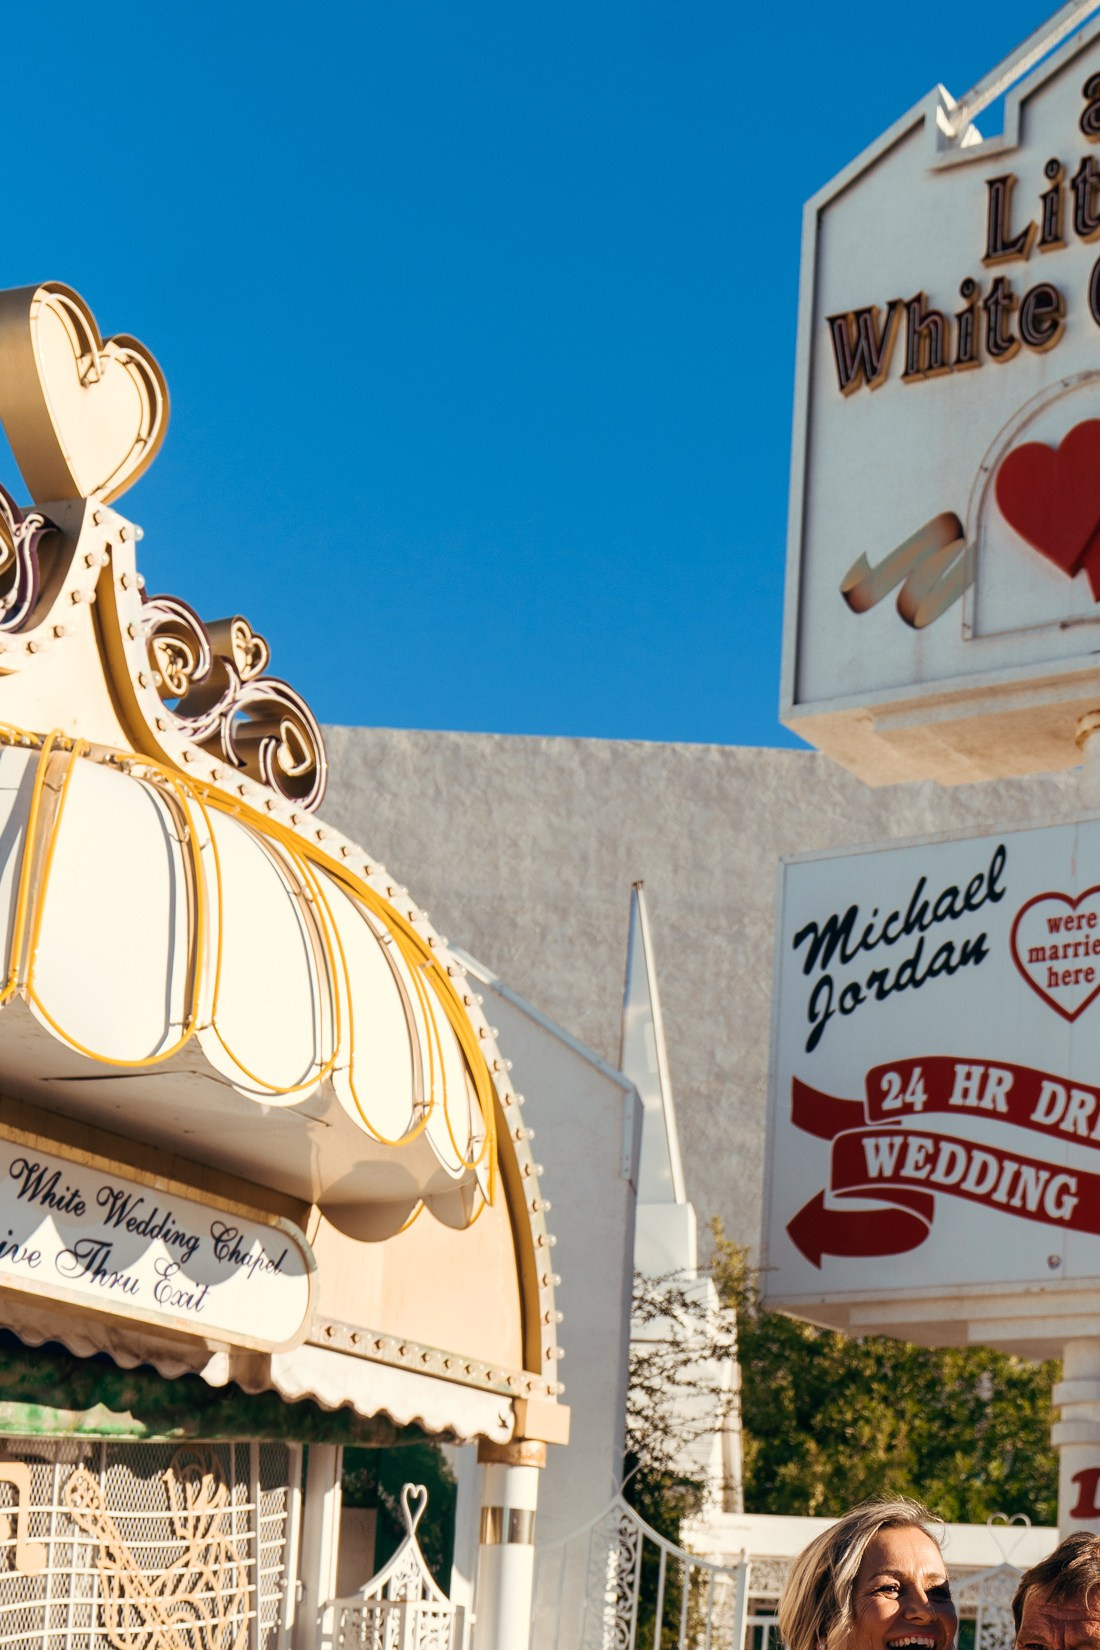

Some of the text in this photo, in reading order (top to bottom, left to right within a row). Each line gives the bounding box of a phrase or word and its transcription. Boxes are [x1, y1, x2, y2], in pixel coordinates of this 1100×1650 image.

[825, 276, 1066, 397] White
[792, 843, 1007, 975] Michael
[1046, 912, 1098, 934] were
[804, 932, 989, 1054] Jordan
[1046, 966, 1095, 988] here
[880, 1068, 928, 1112] 24
[952, 1064, 1012, 1113] HR
[9, 1158, 288, 1279] White Wedding Chapel
[862, 1137, 1080, 1222] WEDDING
[55, 1238, 140, 1296] Thru
[153, 1257, 211, 1313] Exit
